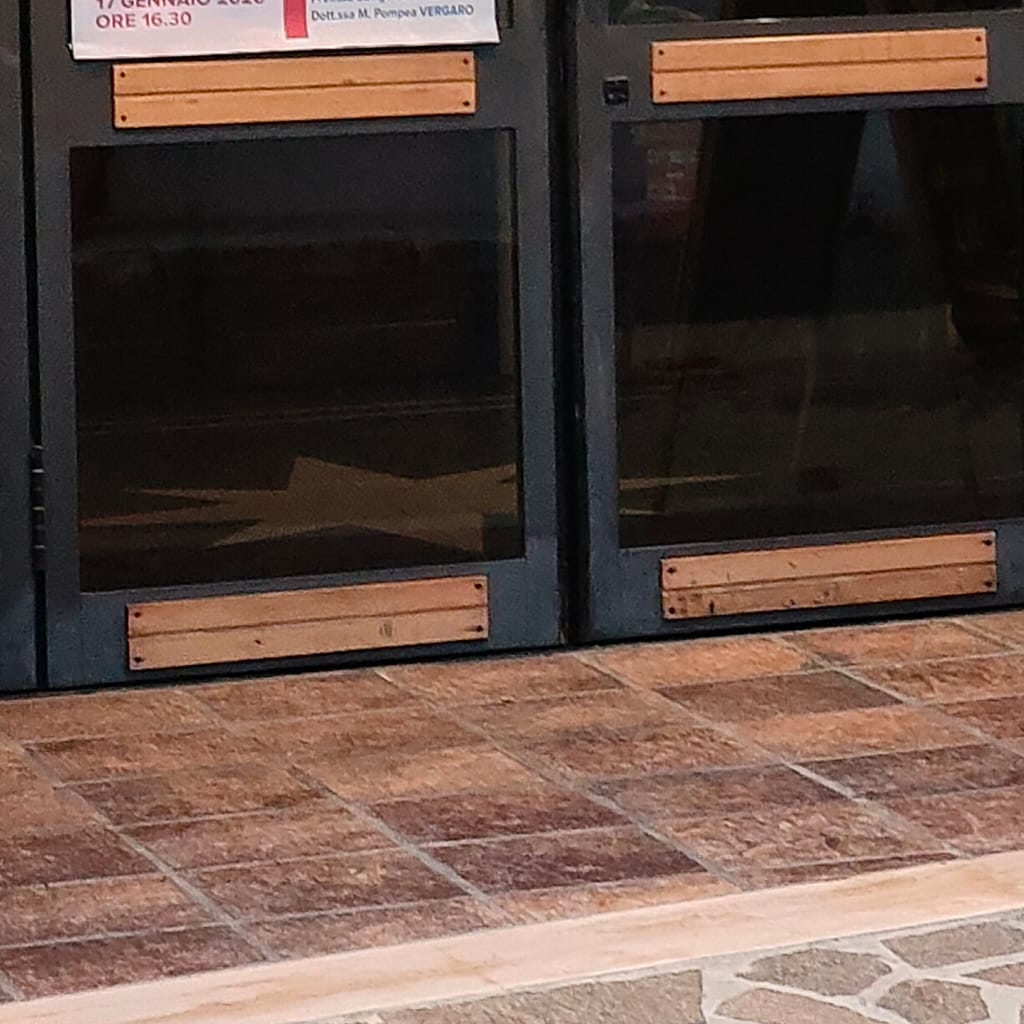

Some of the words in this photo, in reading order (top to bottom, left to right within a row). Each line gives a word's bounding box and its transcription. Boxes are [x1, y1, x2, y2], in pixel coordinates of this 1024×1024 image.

[96, 13, 136, 29] ORE
[142, 11, 192, 27] 16.30
[374, 6, 417, 22] Pompea
[420, 5, 474, 18] VERGARO
